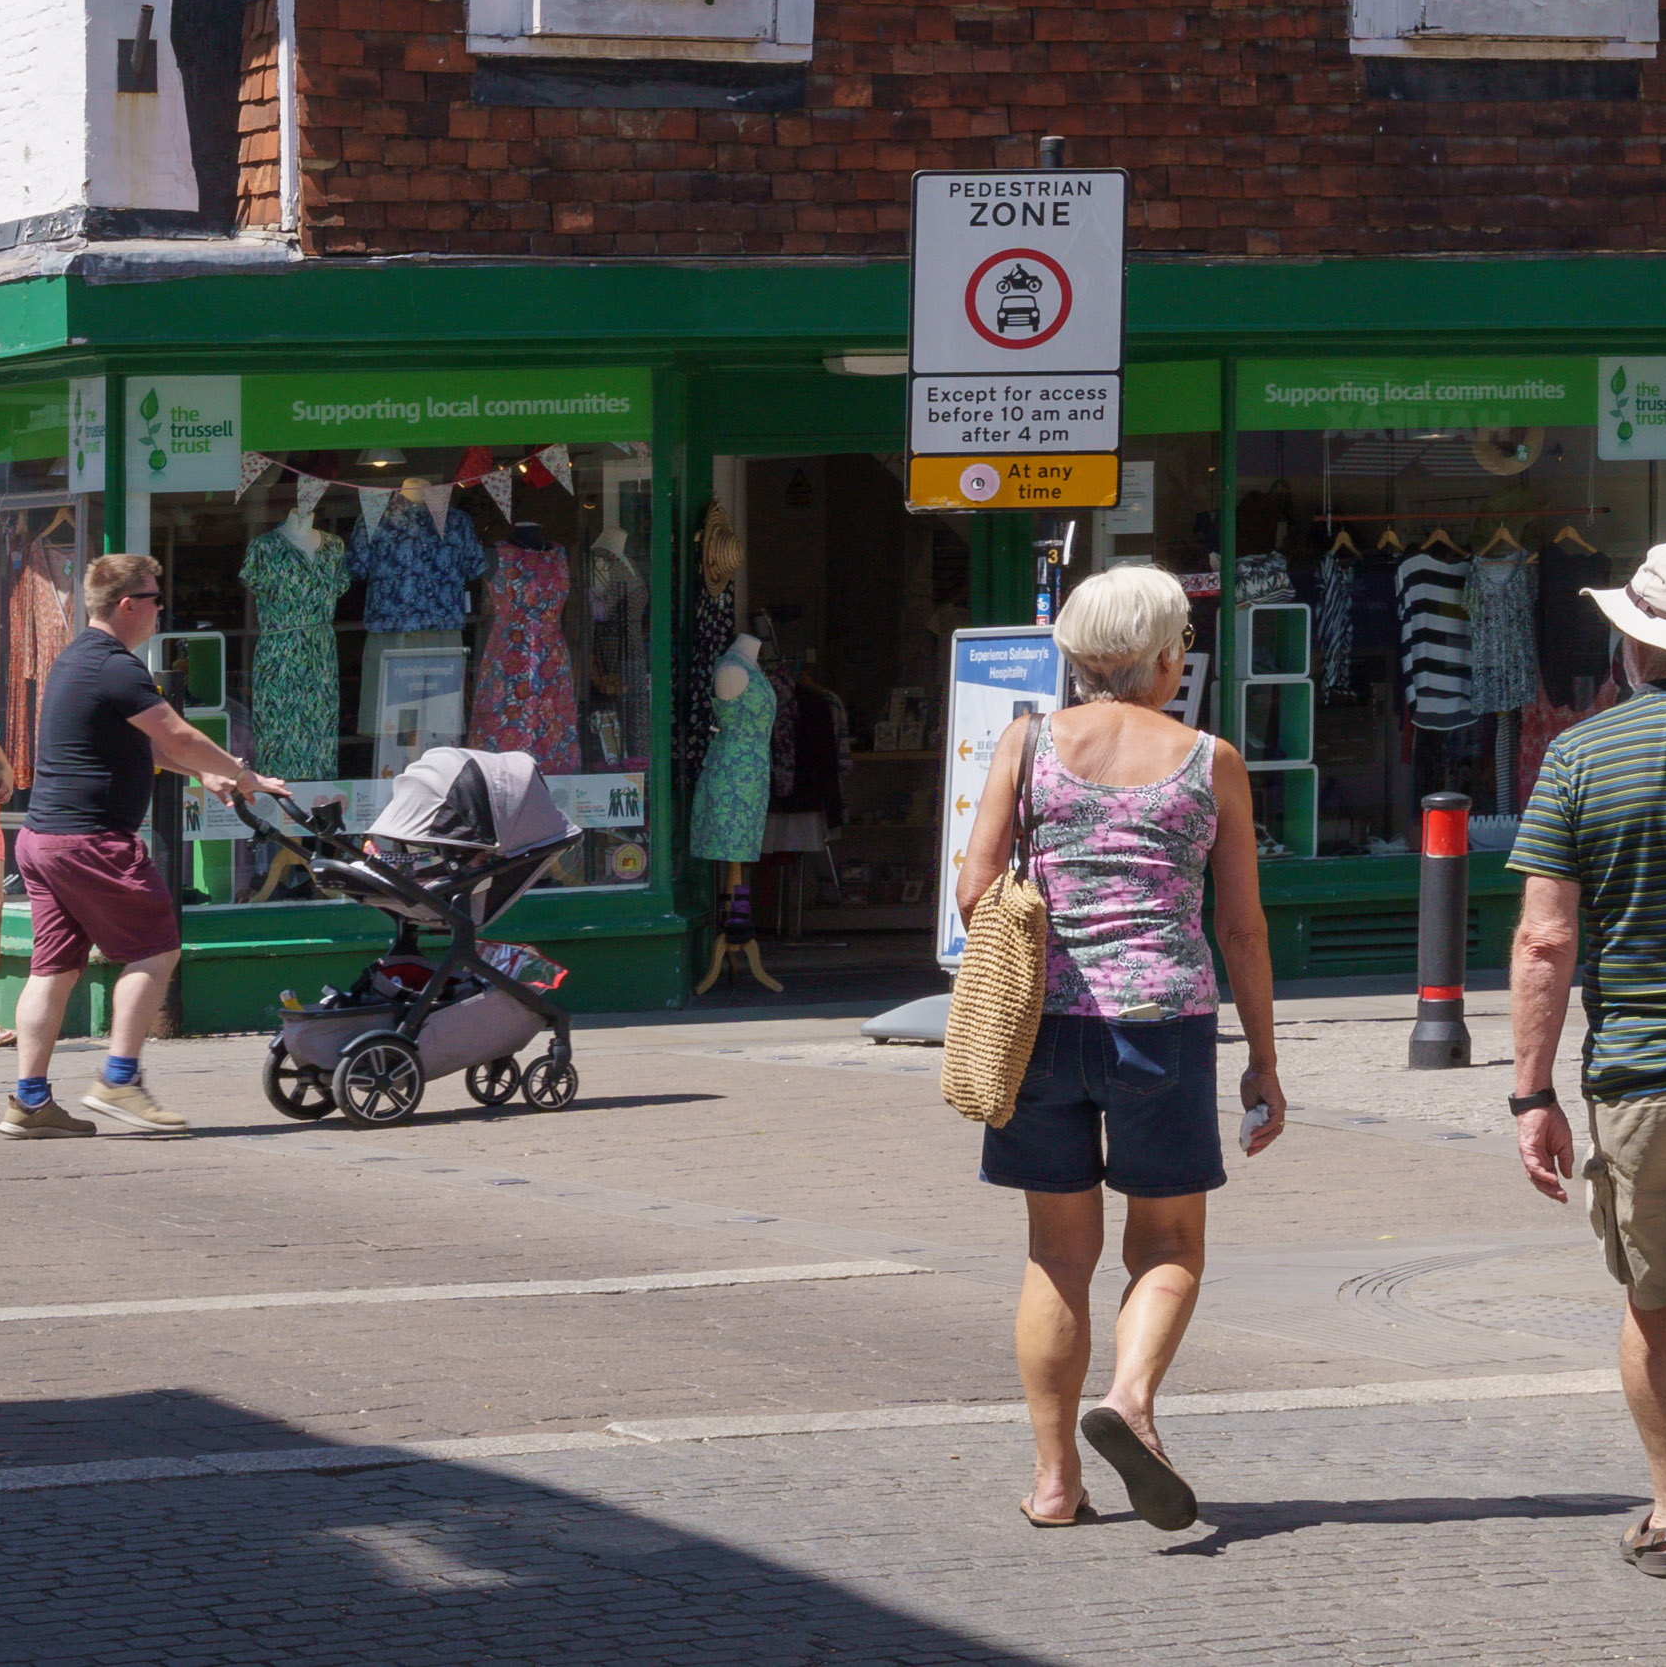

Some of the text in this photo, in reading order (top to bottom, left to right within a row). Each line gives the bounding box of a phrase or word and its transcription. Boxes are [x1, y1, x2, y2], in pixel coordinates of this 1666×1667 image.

[950, 180, 1092, 198] PEDESTRIAN
[969, 201, 1071, 227] ZONE
[927, 386, 1108, 404] Except for access
[1265, 379, 1565, 407] Supporting local communities
[1636, 382, 1660, 397] the
[170, 406, 200, 422] the
[292, 392, 631, 425] Supporting local communities
[928, 405, 1105, 423] before 10 am and
[170, 420, 233, 438] trussell
[962, 426, 1069, 444] after 4 pm
[170, 438, 212, 454] trust
[1008, 463, 1073, 481] At any
[1018, 484, 1062, 499] time
[1047, 549, 1059, 564] 3
[969, 646, 1050, 664] Experience Salisbury's
[989, 665, 1028, 681] Hospitality
